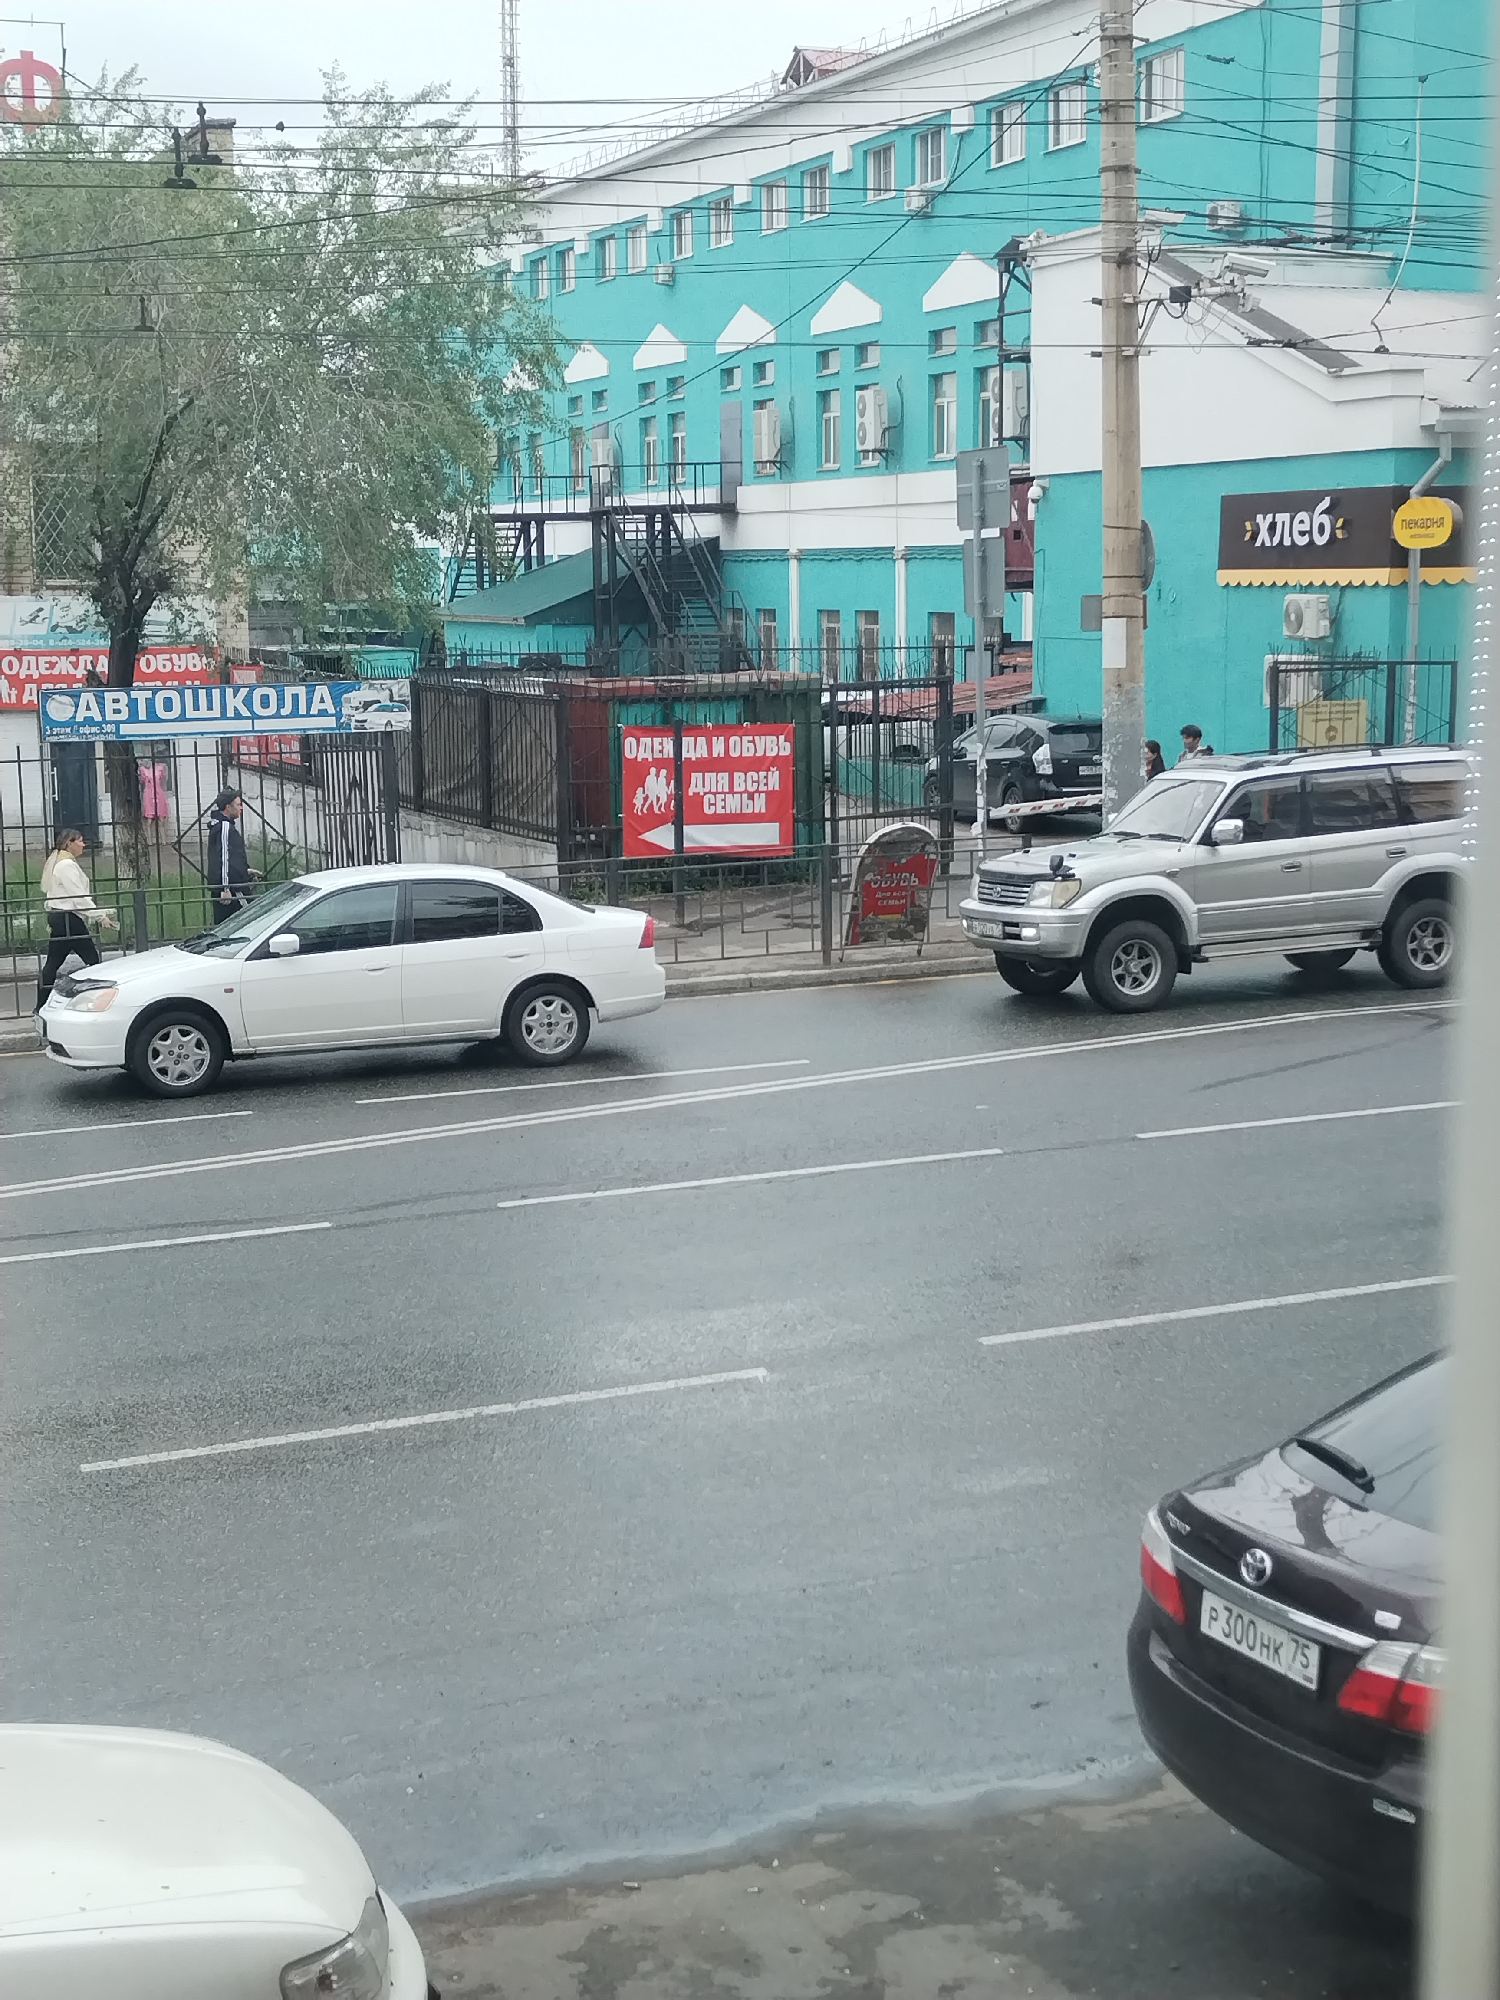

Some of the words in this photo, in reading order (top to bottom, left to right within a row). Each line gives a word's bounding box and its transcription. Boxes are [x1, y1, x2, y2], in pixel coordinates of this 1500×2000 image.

[1254, 496, 1331, 547] хлеб
[1400, 516, 1445, 531] пекарня
[75, 685, 336, 722] АВТОШКОЛА
[45, 724, 51, 735] 3
[79, 724, 100, 735] офис
[101, 723, 116, 733] 309
[712, 736, 725, 758] И
[728, 734, 791, 759] ОБУВЬ
[688, 771, 730, 796] ДЛЯ
[733, 766, 781, 793] ВСЕЙ
[703, 792, 767, 815] СЕМЬИ
